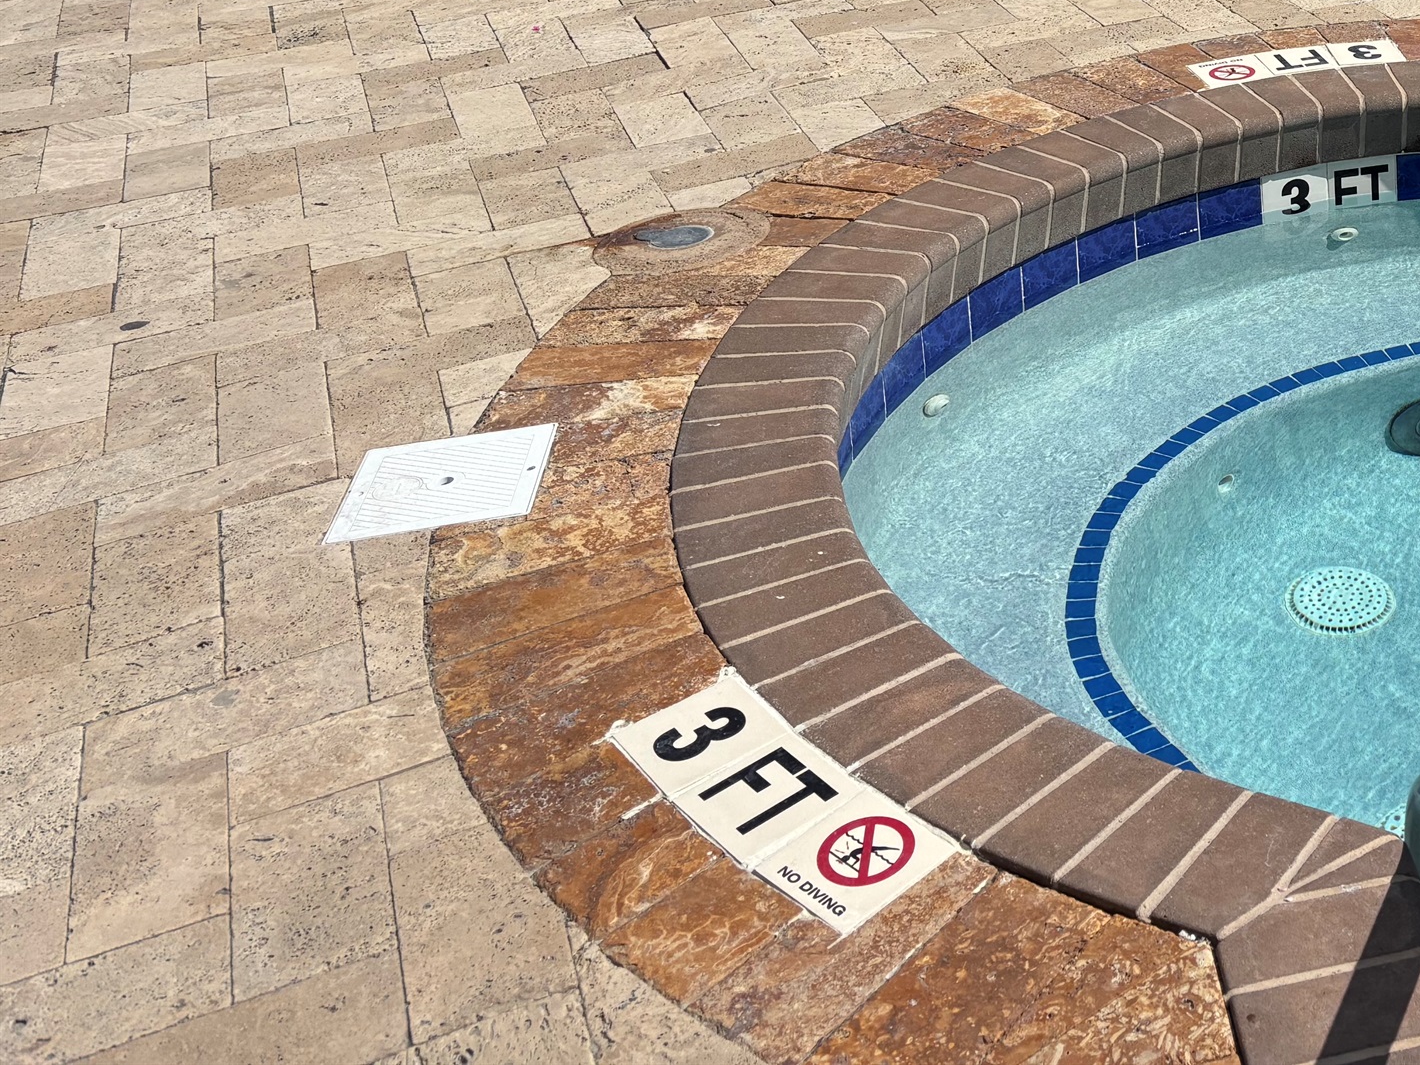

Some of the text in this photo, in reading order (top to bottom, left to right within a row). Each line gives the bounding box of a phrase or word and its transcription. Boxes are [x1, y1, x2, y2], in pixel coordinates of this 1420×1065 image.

[1273, 44, 1382, 71] 3 FT
[1281, 164, 1389, 215] 3 FT
[652, 706, 840, 835] 3 FT
[776, 865, 847, 917] NO DIVING
